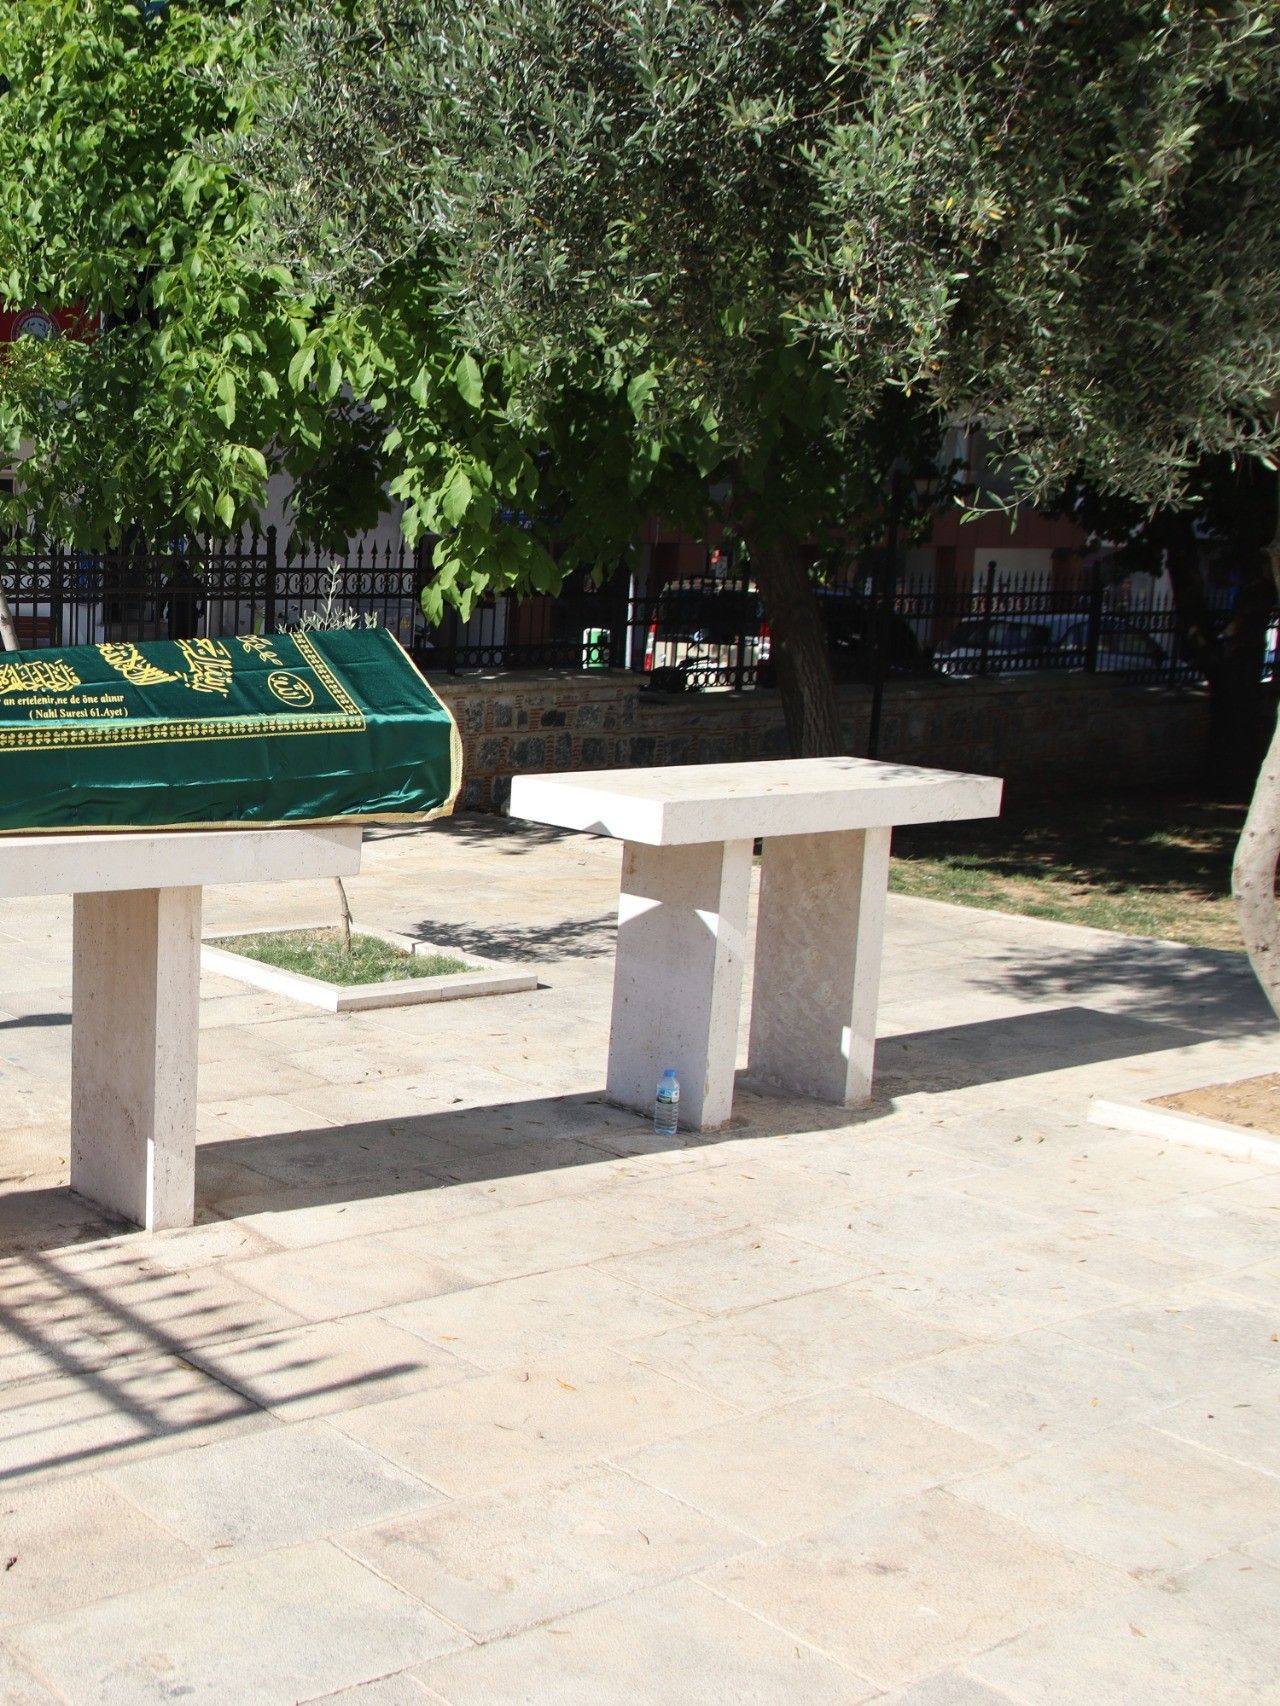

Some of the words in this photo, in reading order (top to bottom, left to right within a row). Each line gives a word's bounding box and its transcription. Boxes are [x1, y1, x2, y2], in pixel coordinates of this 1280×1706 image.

[70, 695, 80, 705] de
[82, 694, 98, 705] öne
[101, 693, 124, 704] alınır
[60, 707, 88, 718] Suresi
[90, 707, 122, 719] 61.Ayet
